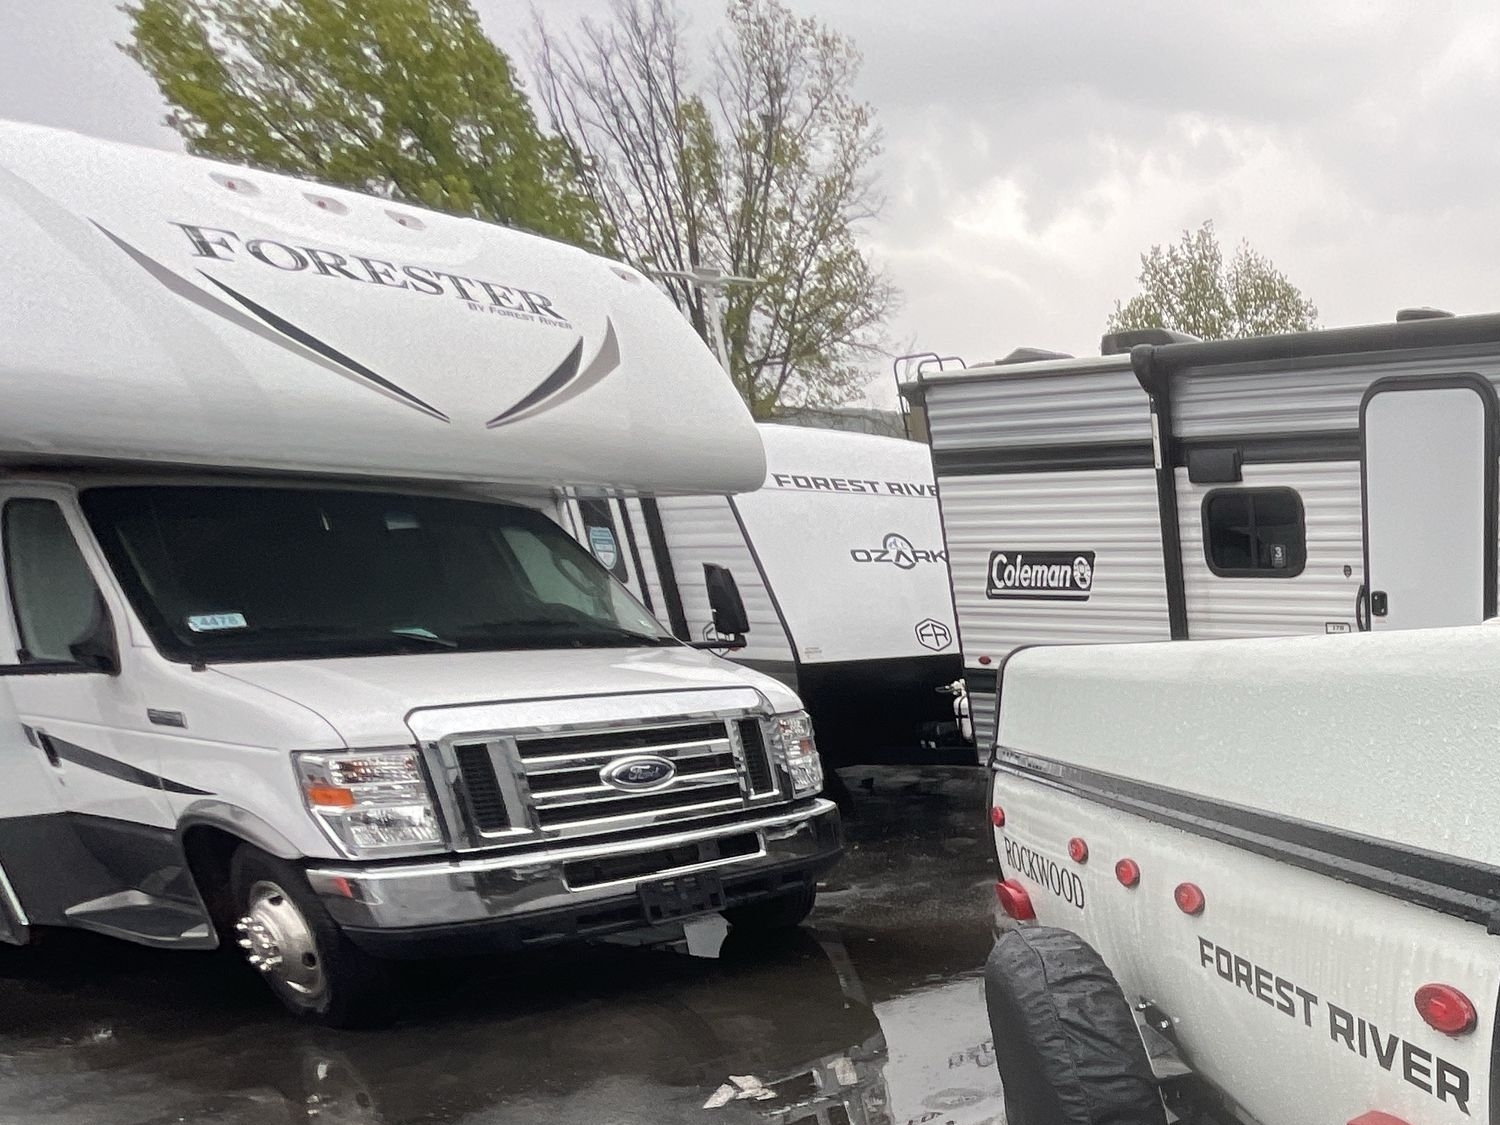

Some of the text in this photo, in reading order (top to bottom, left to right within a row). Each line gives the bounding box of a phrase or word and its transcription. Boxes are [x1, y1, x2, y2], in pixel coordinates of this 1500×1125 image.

[167, 221, 569, 321] FORESTER
[771, 473, 938, 497] FOREST RIVE
[850, 549, 948, 564] OZARK
[992, 553, 1072, 589] Coleman
[629, 764, 660, 781] Ford
[1004, 836, 1085, 909] ROCKWOOD
[1197, 935, 1471, 1117] FOREST RIVER
